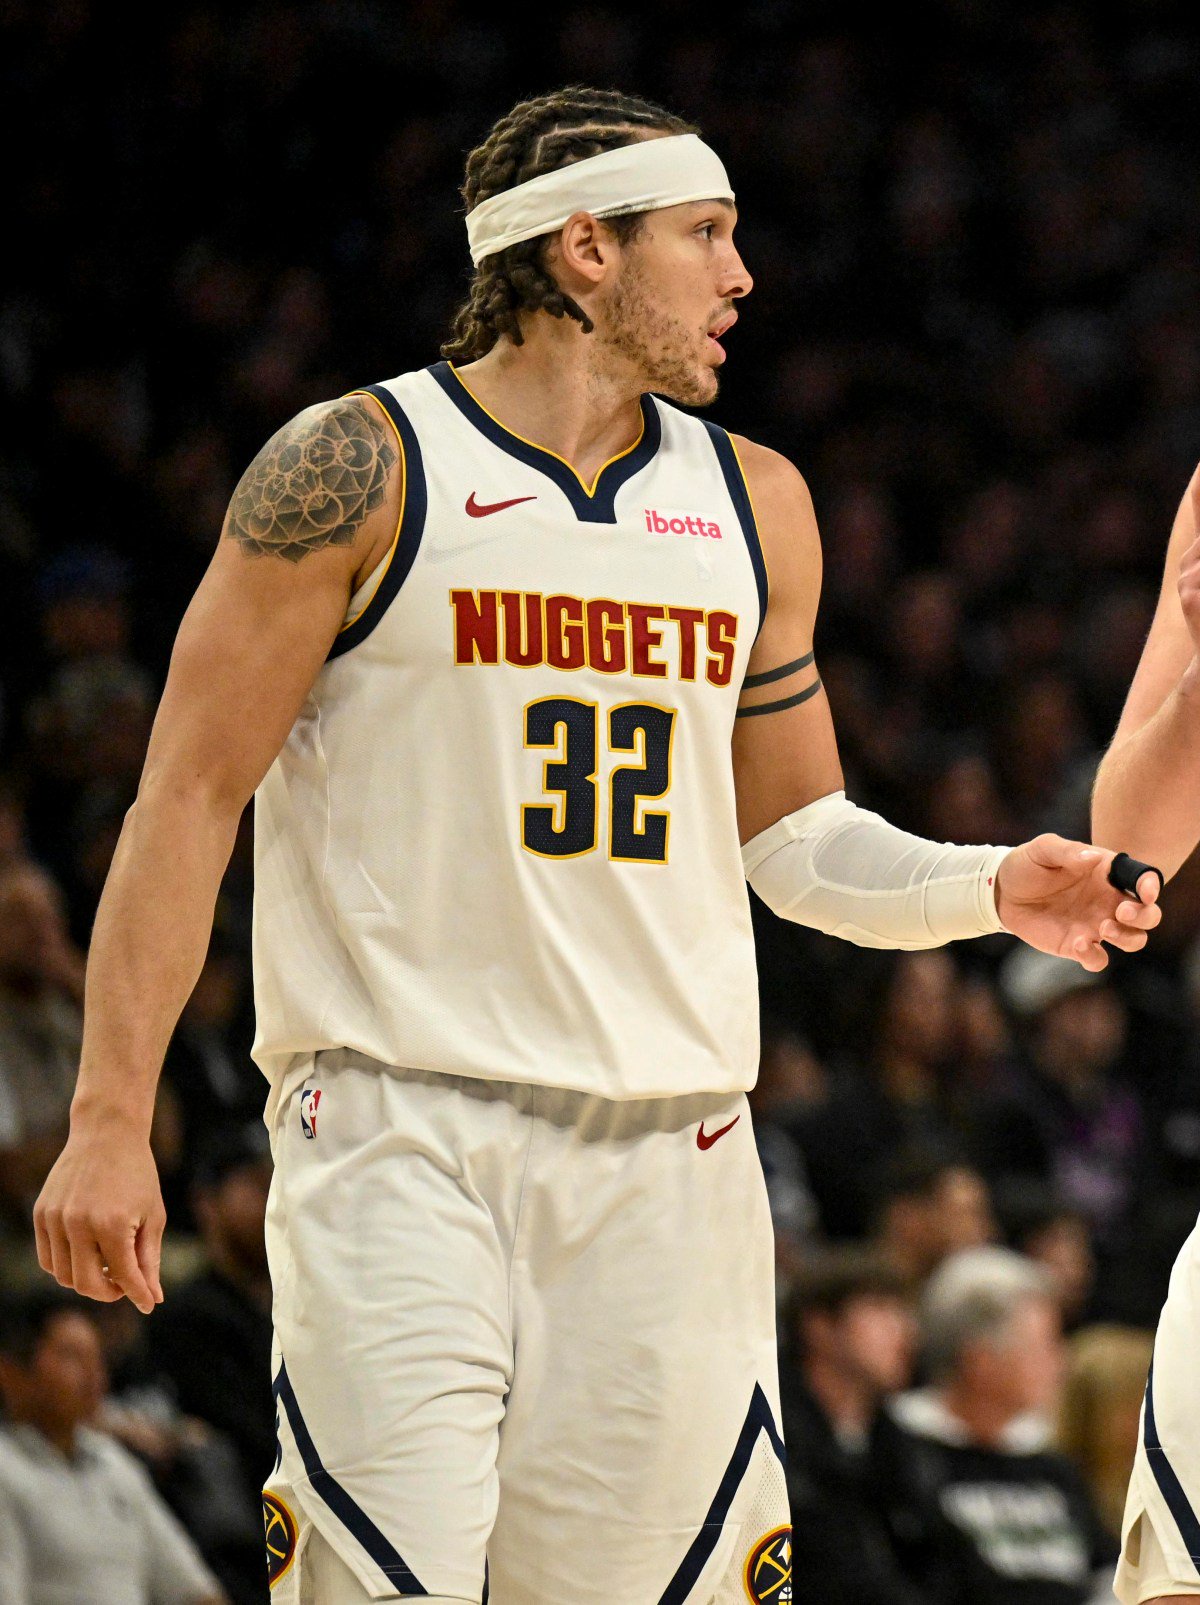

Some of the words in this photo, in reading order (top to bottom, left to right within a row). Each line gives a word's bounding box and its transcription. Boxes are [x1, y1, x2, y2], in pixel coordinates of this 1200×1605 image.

[645, 510, 722, 540] ibotta
[449, 588, 738, 688] NUGGETS
[520, 695, 678, 865] 32
